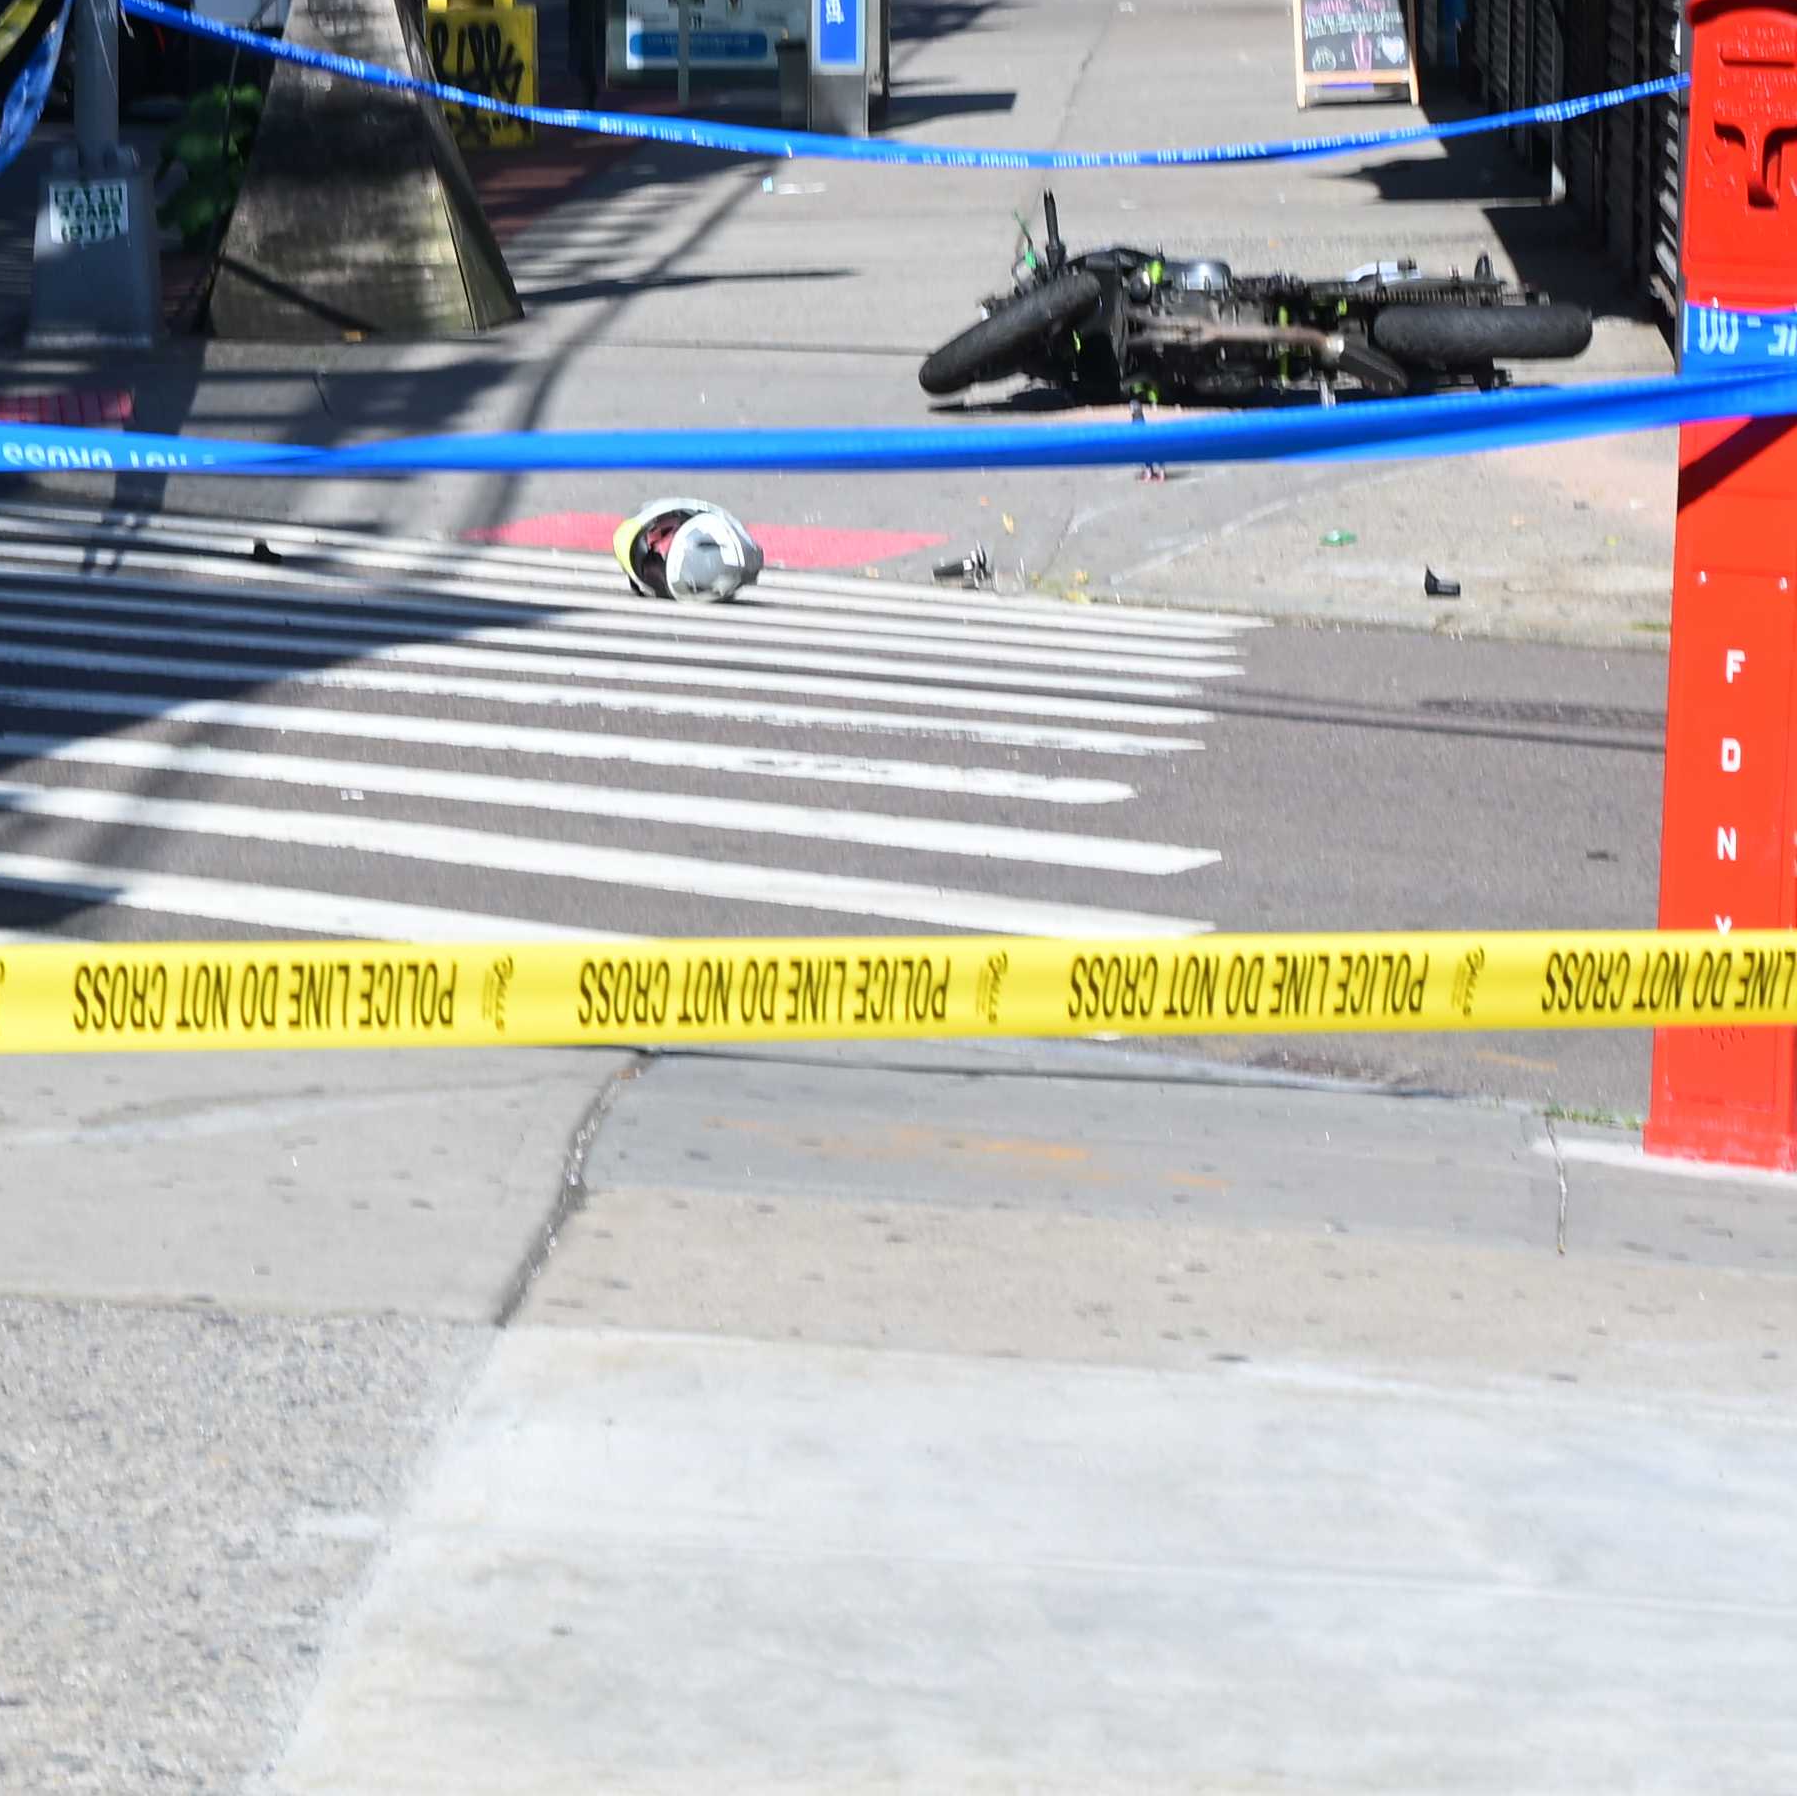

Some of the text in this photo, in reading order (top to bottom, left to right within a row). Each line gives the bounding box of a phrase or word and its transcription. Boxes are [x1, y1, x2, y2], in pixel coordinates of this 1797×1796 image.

[73, 963, 457, 1030] POLICE LINE DO NOT CROSS
[577, 959, 951, 1025] POLICE LINE DO NOT CROSS
[1067, 954, 1429, 1019] POLICE LINE DO NOT CROSS
[1541, 951, 1797, 1012] LINE DO NOT CROSS
